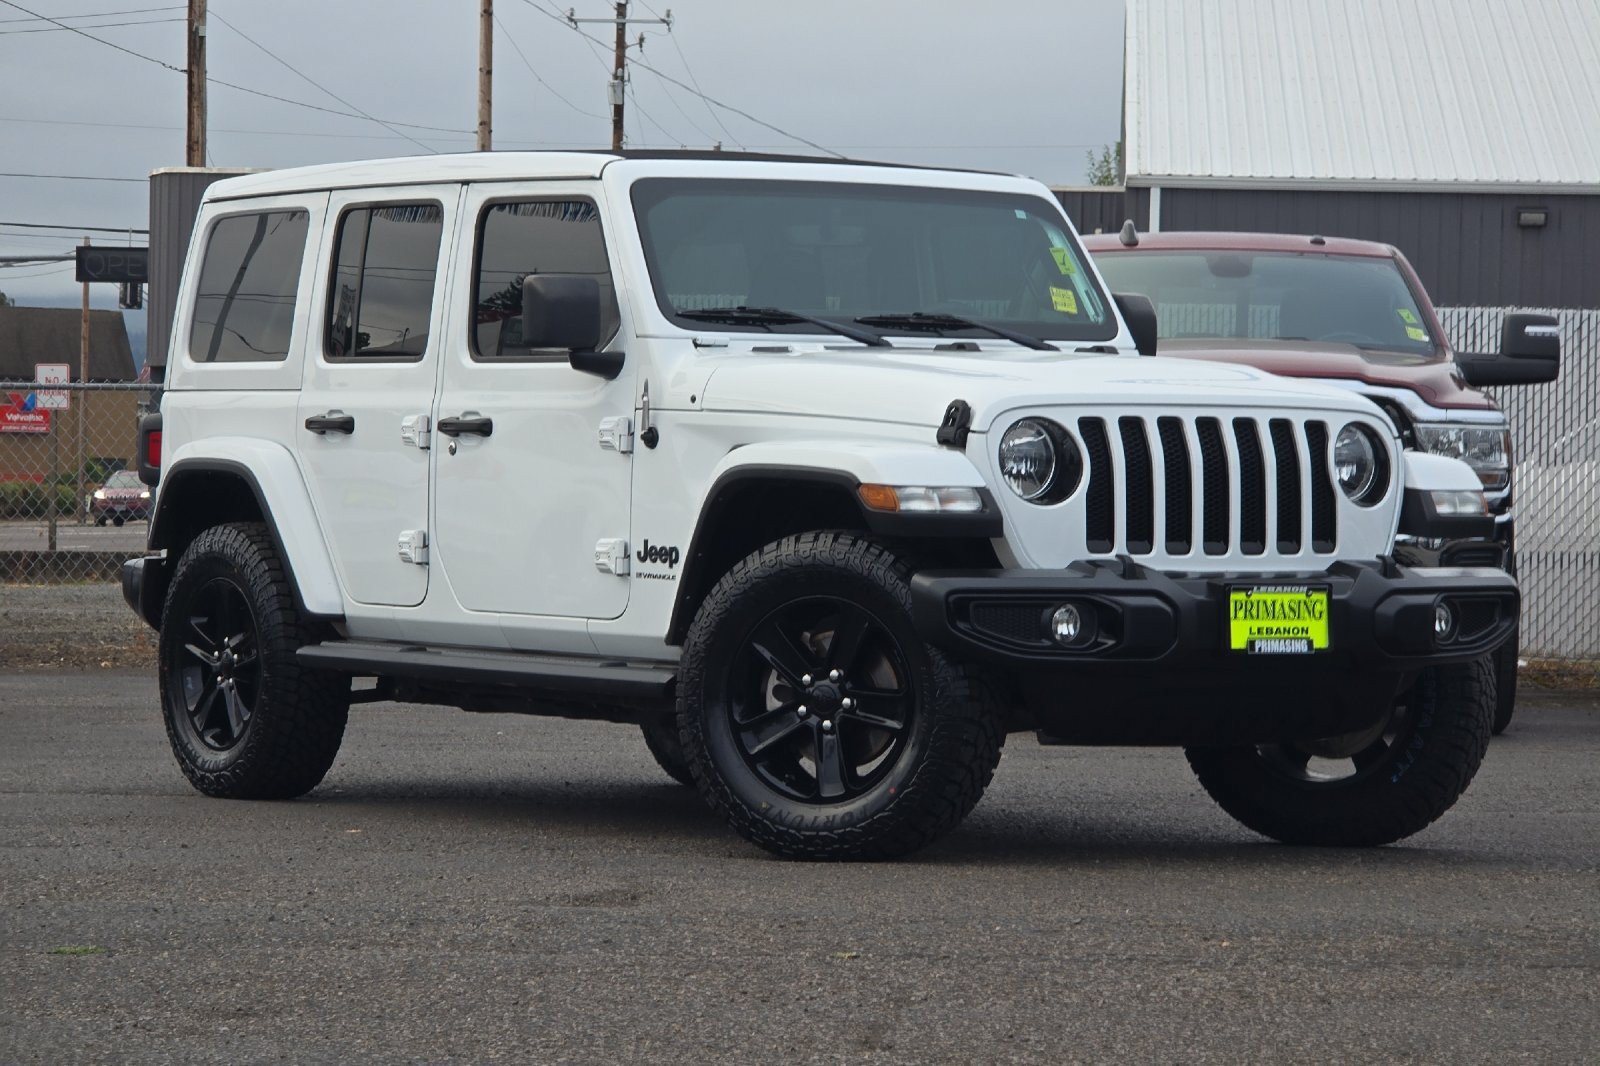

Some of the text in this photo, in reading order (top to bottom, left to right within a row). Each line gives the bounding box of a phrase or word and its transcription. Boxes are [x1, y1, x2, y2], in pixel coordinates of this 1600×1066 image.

[85, 254, 143, 278] OPE
[45, 376, 60, 385] NO
[636, 538, 680, 569] Jeep
[1233, 599, 1323, 620] PRIMASING
[1249, 626, 1309, 635] LEBANON
[1255, 639, 1308, 653] PRIMASING
